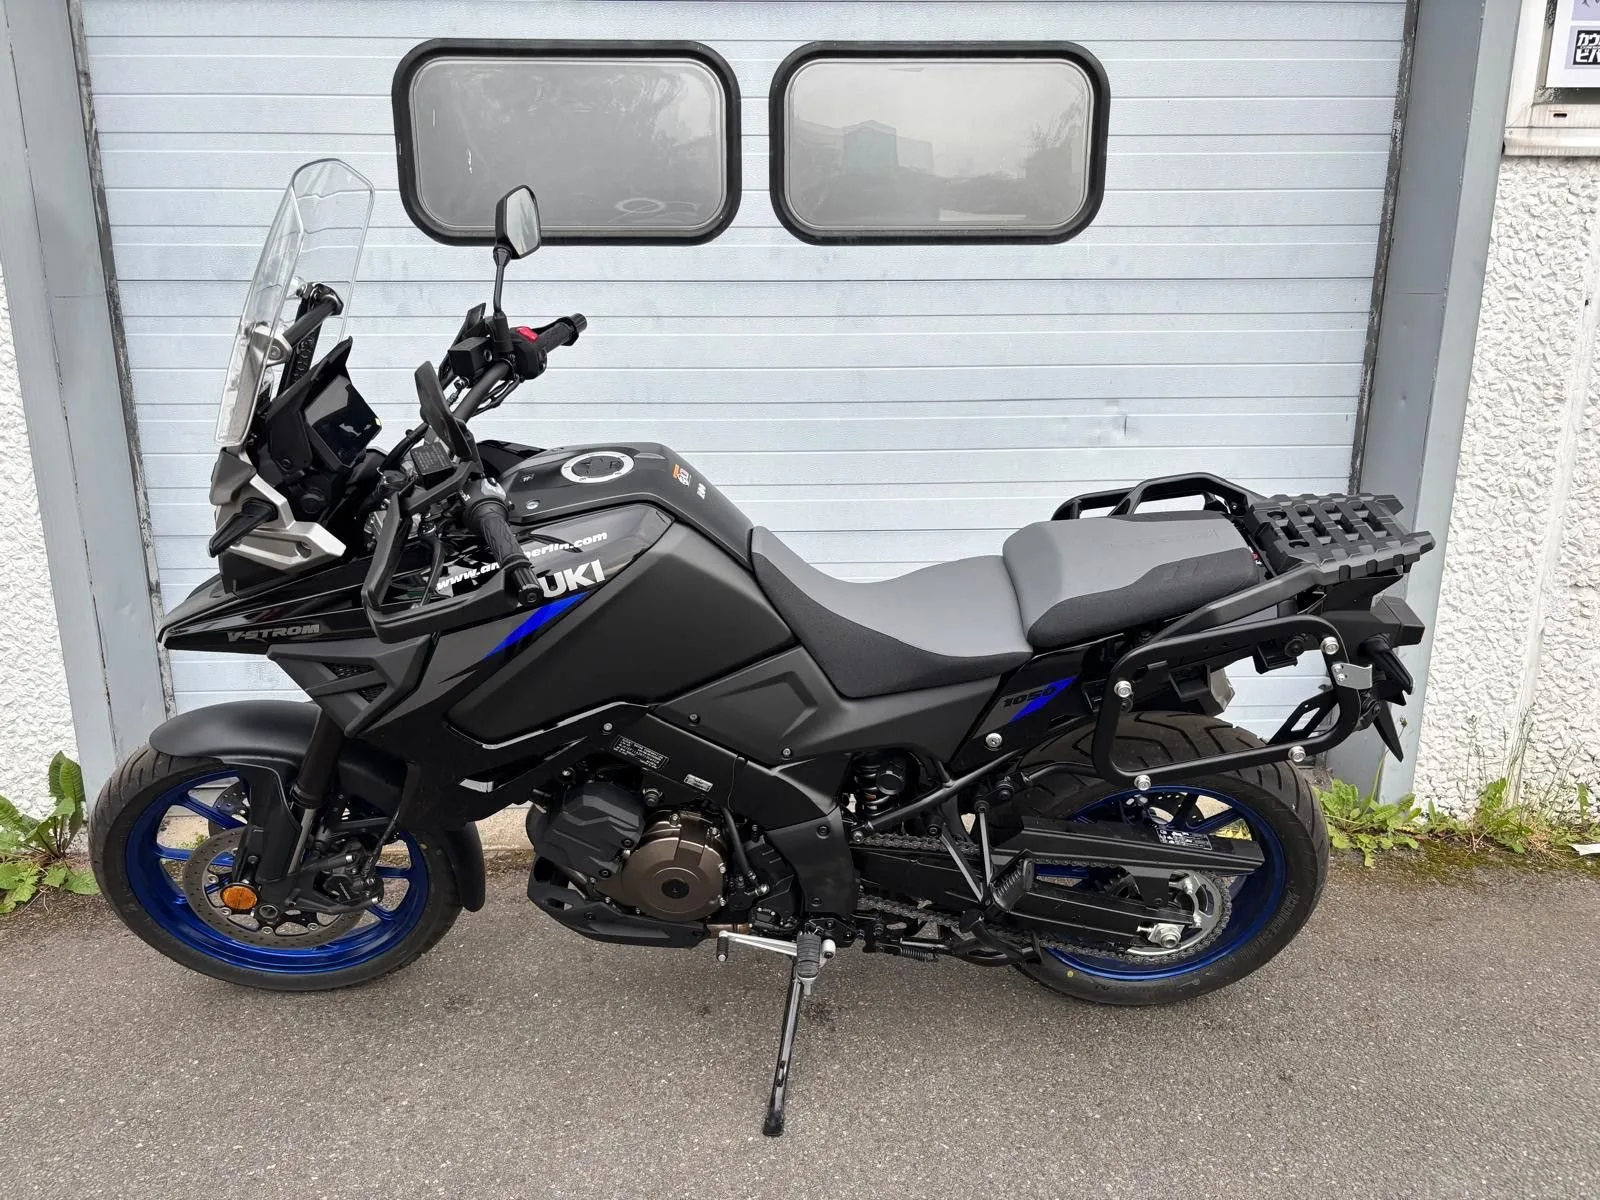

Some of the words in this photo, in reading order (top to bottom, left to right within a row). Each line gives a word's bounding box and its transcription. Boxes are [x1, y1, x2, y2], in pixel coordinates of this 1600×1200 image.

[1576, 32, 1600, 47] カウ
[537, 559, 605, 597] UKI
[227, 623, 320, 642] V-STROM
[1003, 685, 1058, 707] 1050
